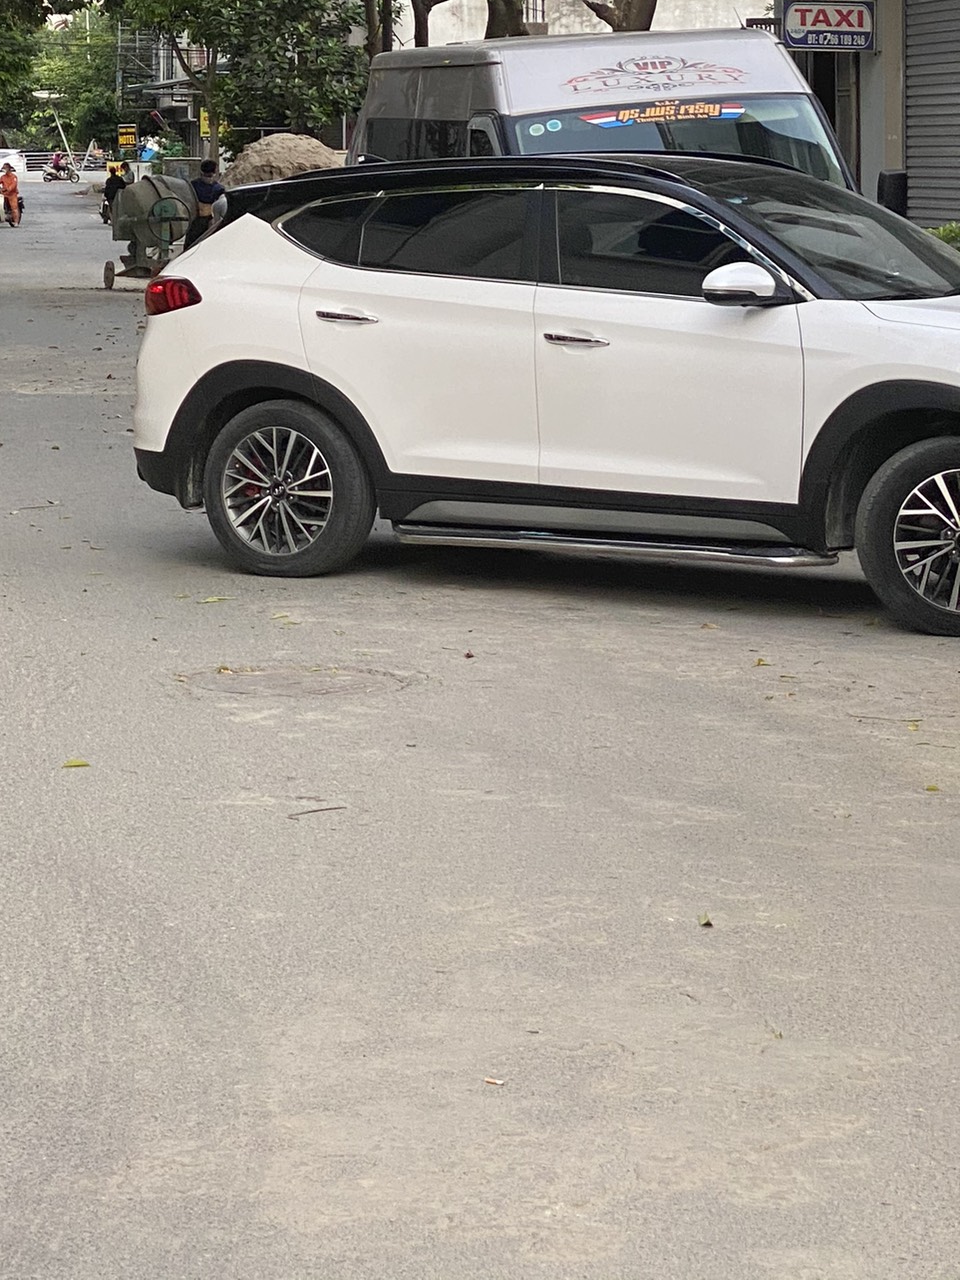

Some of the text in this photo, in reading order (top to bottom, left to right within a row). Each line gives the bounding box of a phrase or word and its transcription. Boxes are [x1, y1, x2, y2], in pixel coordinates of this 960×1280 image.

[794, 8, 864, 28] TAXI
[634, 60, 673, 71] VIP
[571, 73, 746, 92] LUXURY
[119, 135, 136, 144] HOTEL
